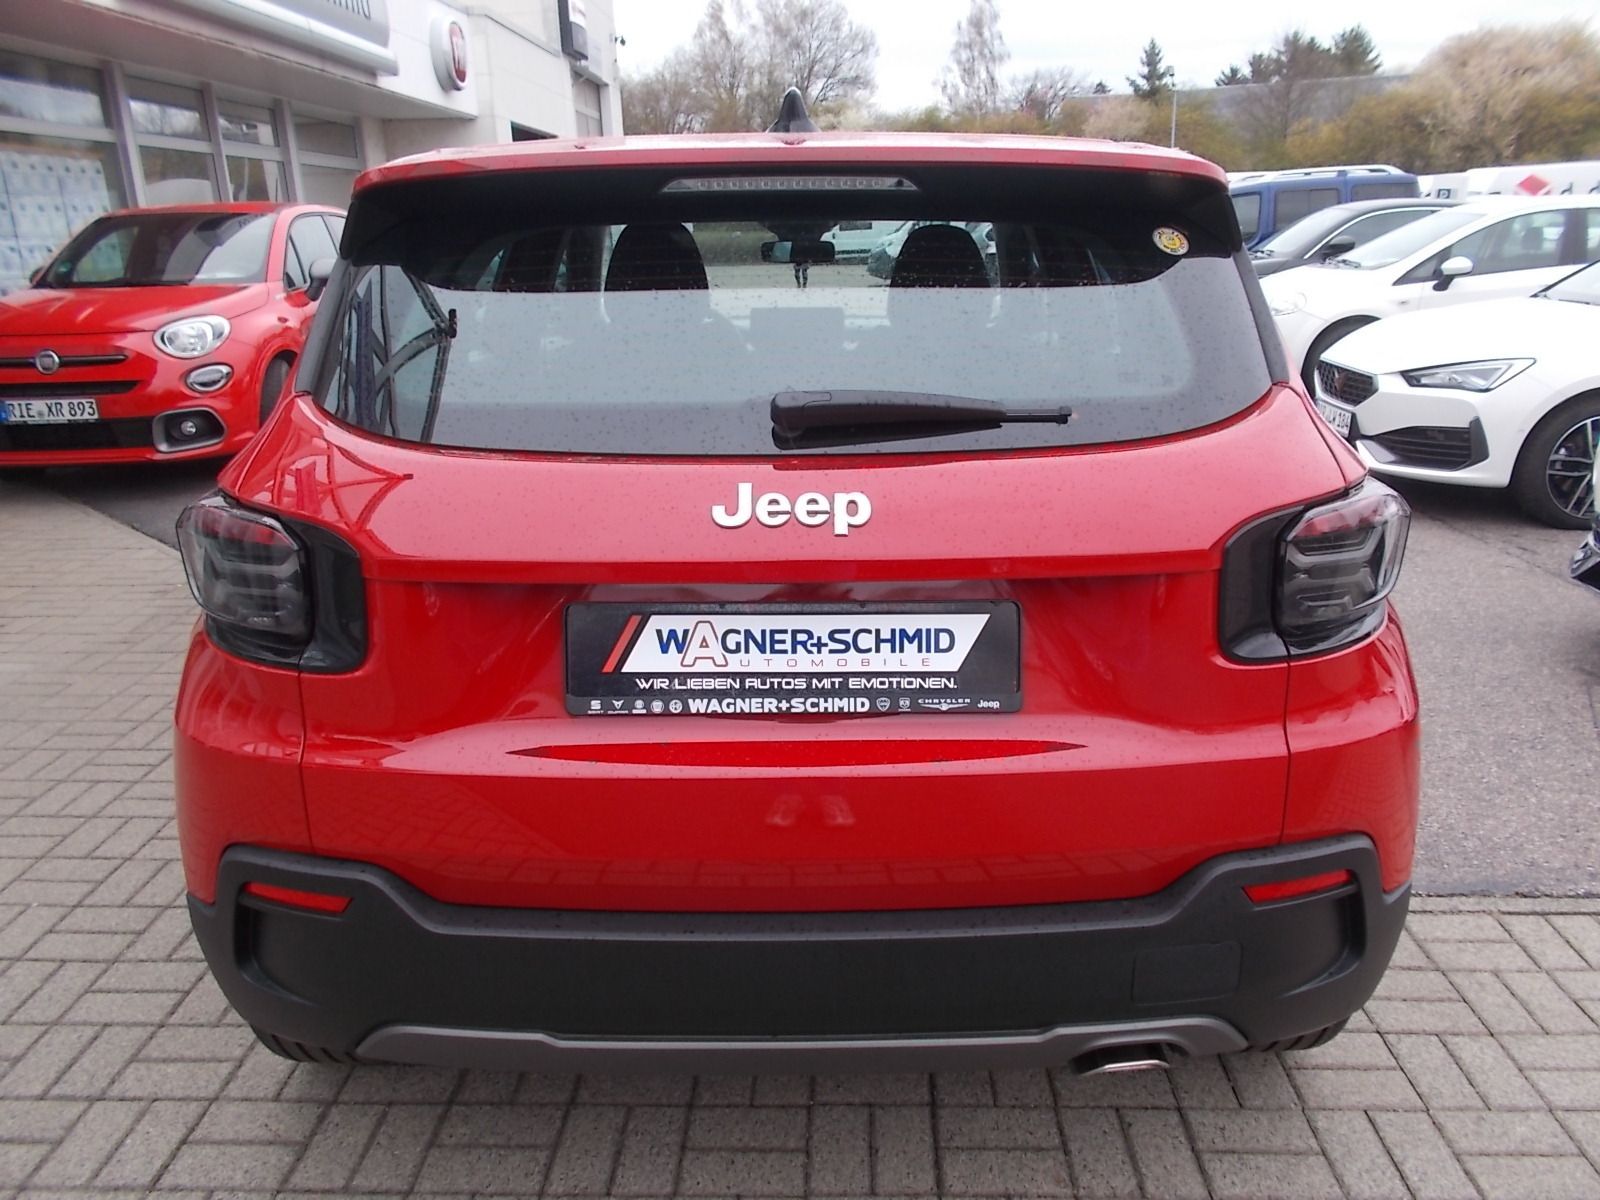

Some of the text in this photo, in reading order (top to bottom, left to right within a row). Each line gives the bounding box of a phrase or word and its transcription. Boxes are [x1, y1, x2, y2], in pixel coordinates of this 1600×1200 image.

[7, 400, 96, 418] RIE XR 893
[711, 482, 872, 536] Jeep
[656, 620, 956, 668] WAGNER+SCHMID
[635, 677, 958, 690] WIR LIEBEN AUTOS MIT EMOTIONEN.
[688, 697, 870, 713] WAGNER+SCHMID
[977, 699, 1000, 710] Jeep
